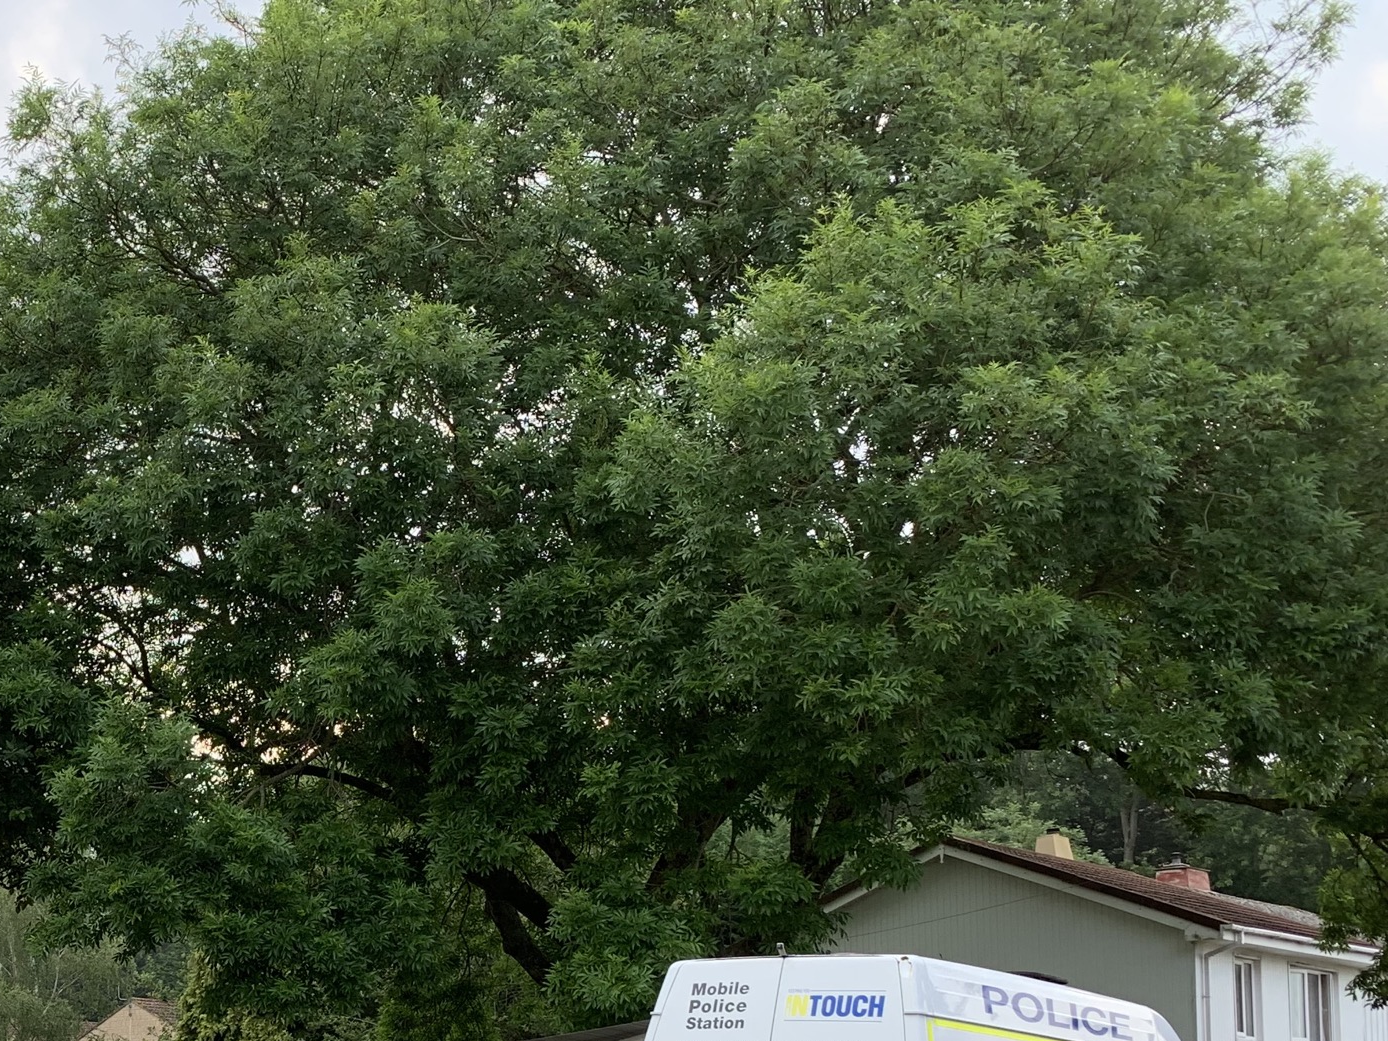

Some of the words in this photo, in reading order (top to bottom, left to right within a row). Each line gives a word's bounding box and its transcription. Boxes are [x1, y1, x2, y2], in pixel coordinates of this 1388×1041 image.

[691, 982, 750, 996] Mobile
[688, 999, 747, 1013] Police
[981, 984, 1134, 1041] POLICE
[685, 1016, 745, 1030] Station
